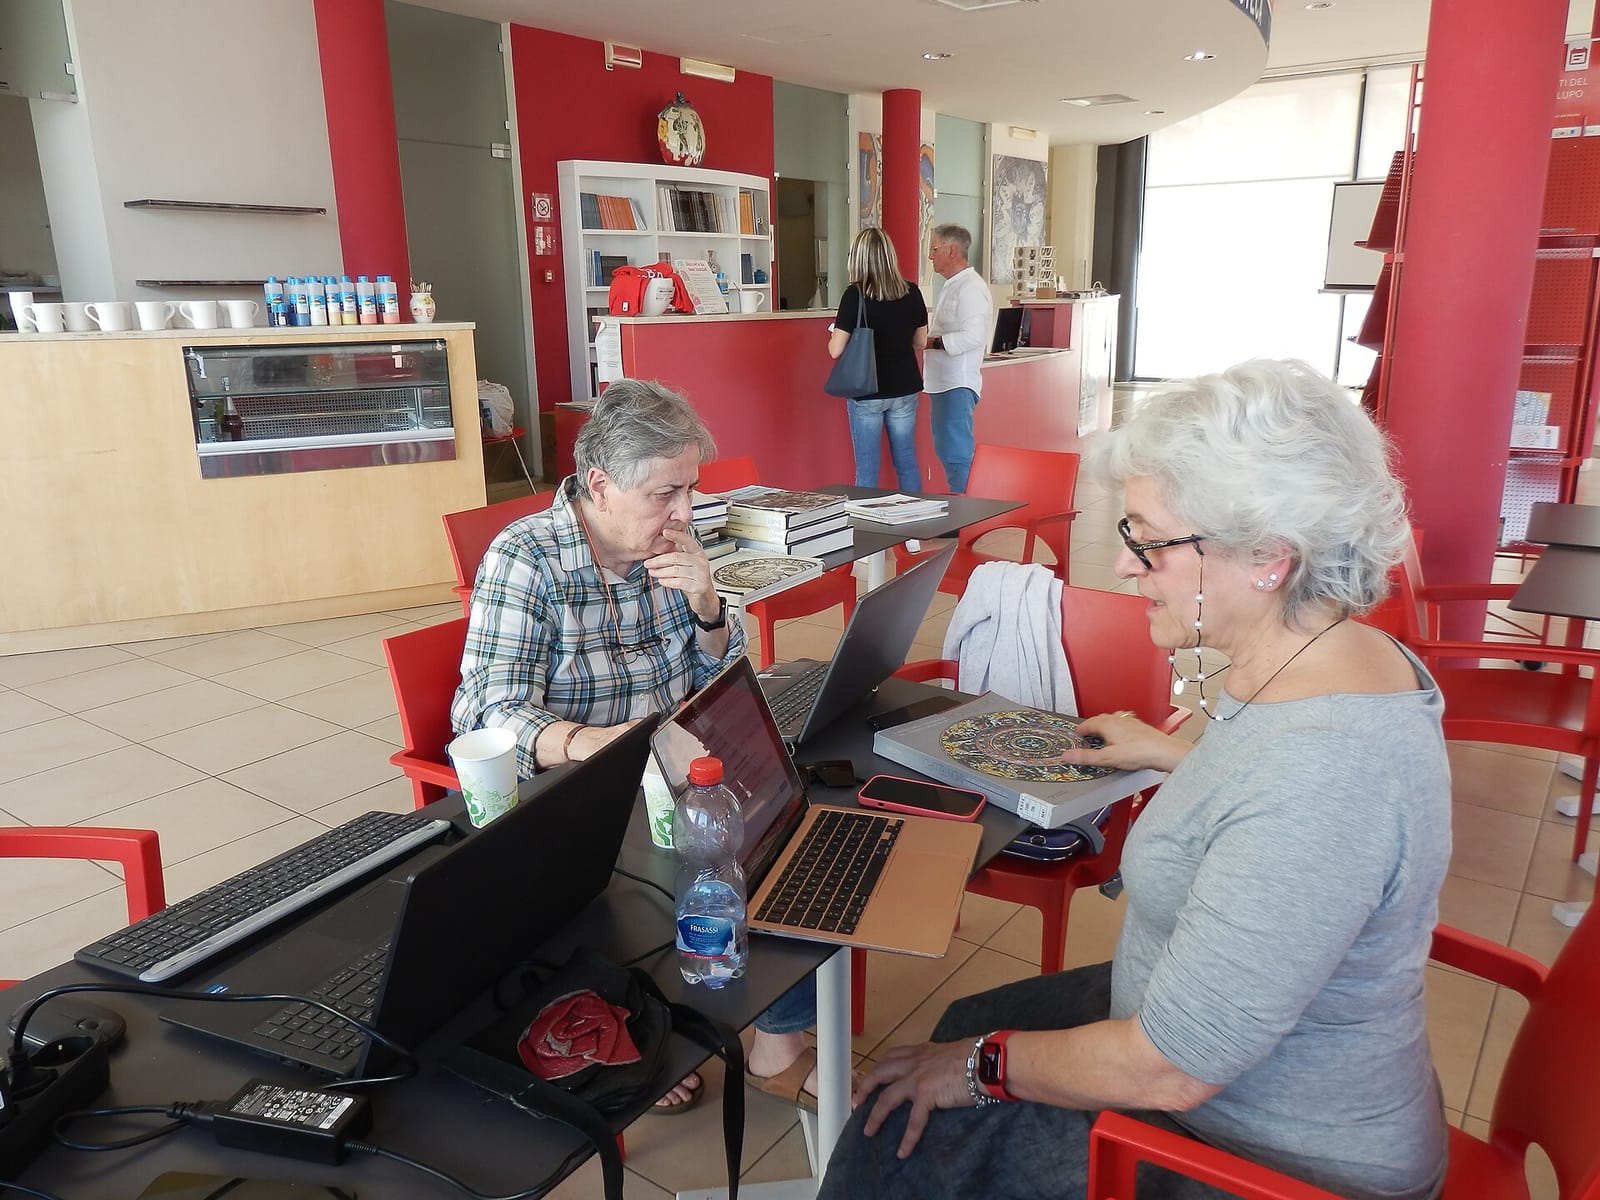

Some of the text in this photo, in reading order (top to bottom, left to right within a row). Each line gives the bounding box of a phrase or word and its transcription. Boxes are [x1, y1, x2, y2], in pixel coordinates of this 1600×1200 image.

[1569, 77, 1589, 87] DEL
[1556, 90, 1584, 100] LUPO
[690, 924, 719, 934] FRASASSI
